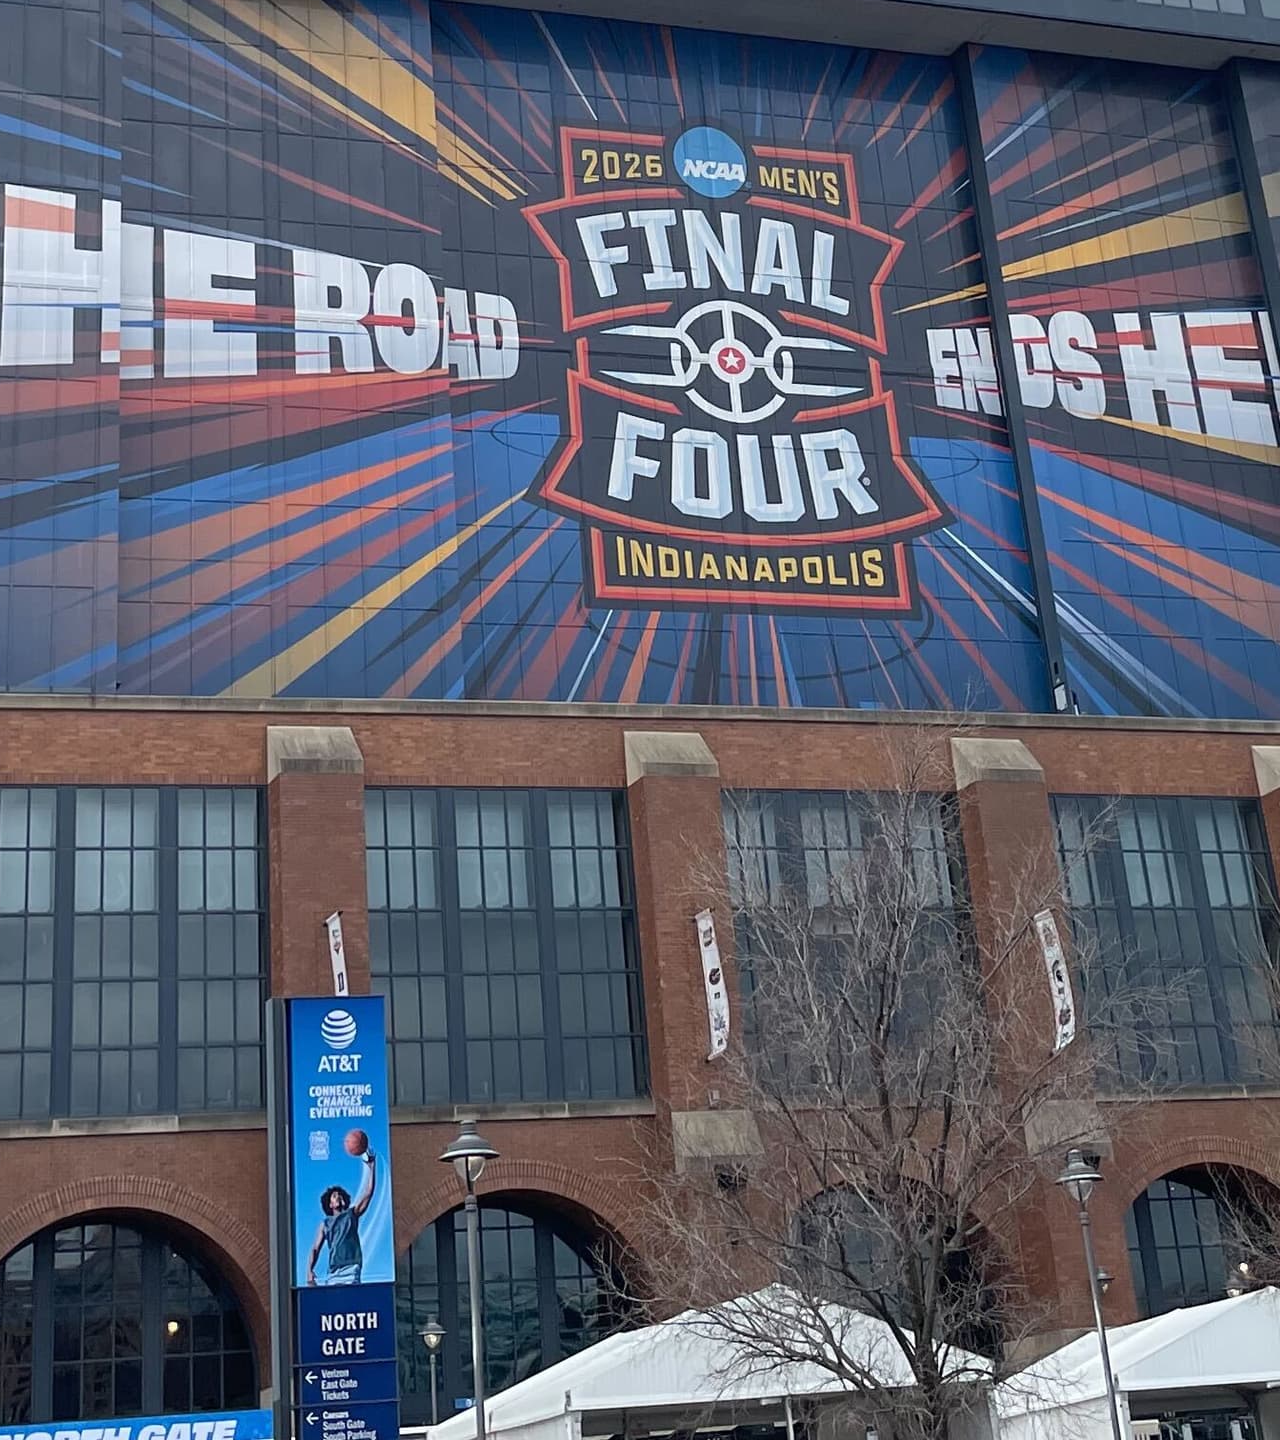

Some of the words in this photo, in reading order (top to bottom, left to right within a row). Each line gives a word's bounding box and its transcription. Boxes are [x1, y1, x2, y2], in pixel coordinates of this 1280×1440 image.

[581, 149, 662, 183] 2026
[683, 159, 746, 182] NCAA
[759, 165, 840, 205] MEN'S
[575, 209, 851, 316] FINAL
[292, 250, 519, 380] ROAD
[926, 311, 1107, 420] ENDS
[607, 411, 880, 523] FOUR
[616, 536, 886, 588] INDIANAPOLIS
[317, 1054, 362, 1073] AT&T
[309, 1084, 372, 1097] CONNECTING
[317, 1095, 362, 1107] CHANGES
[309, 1105, 373, 1119] EVERYTHING
[321, 1312, 378, 1331] NORTH
[322, 1337, 365, 1356] GATE
[321, 1379, 339, 1390] East
[339, 1379, 358, 1389] Gate
[321, 1391, 350, 1400] Tickets
[137, 1420, 238, 1440] GATE
[346, 1419, 366, 1429] Gate
